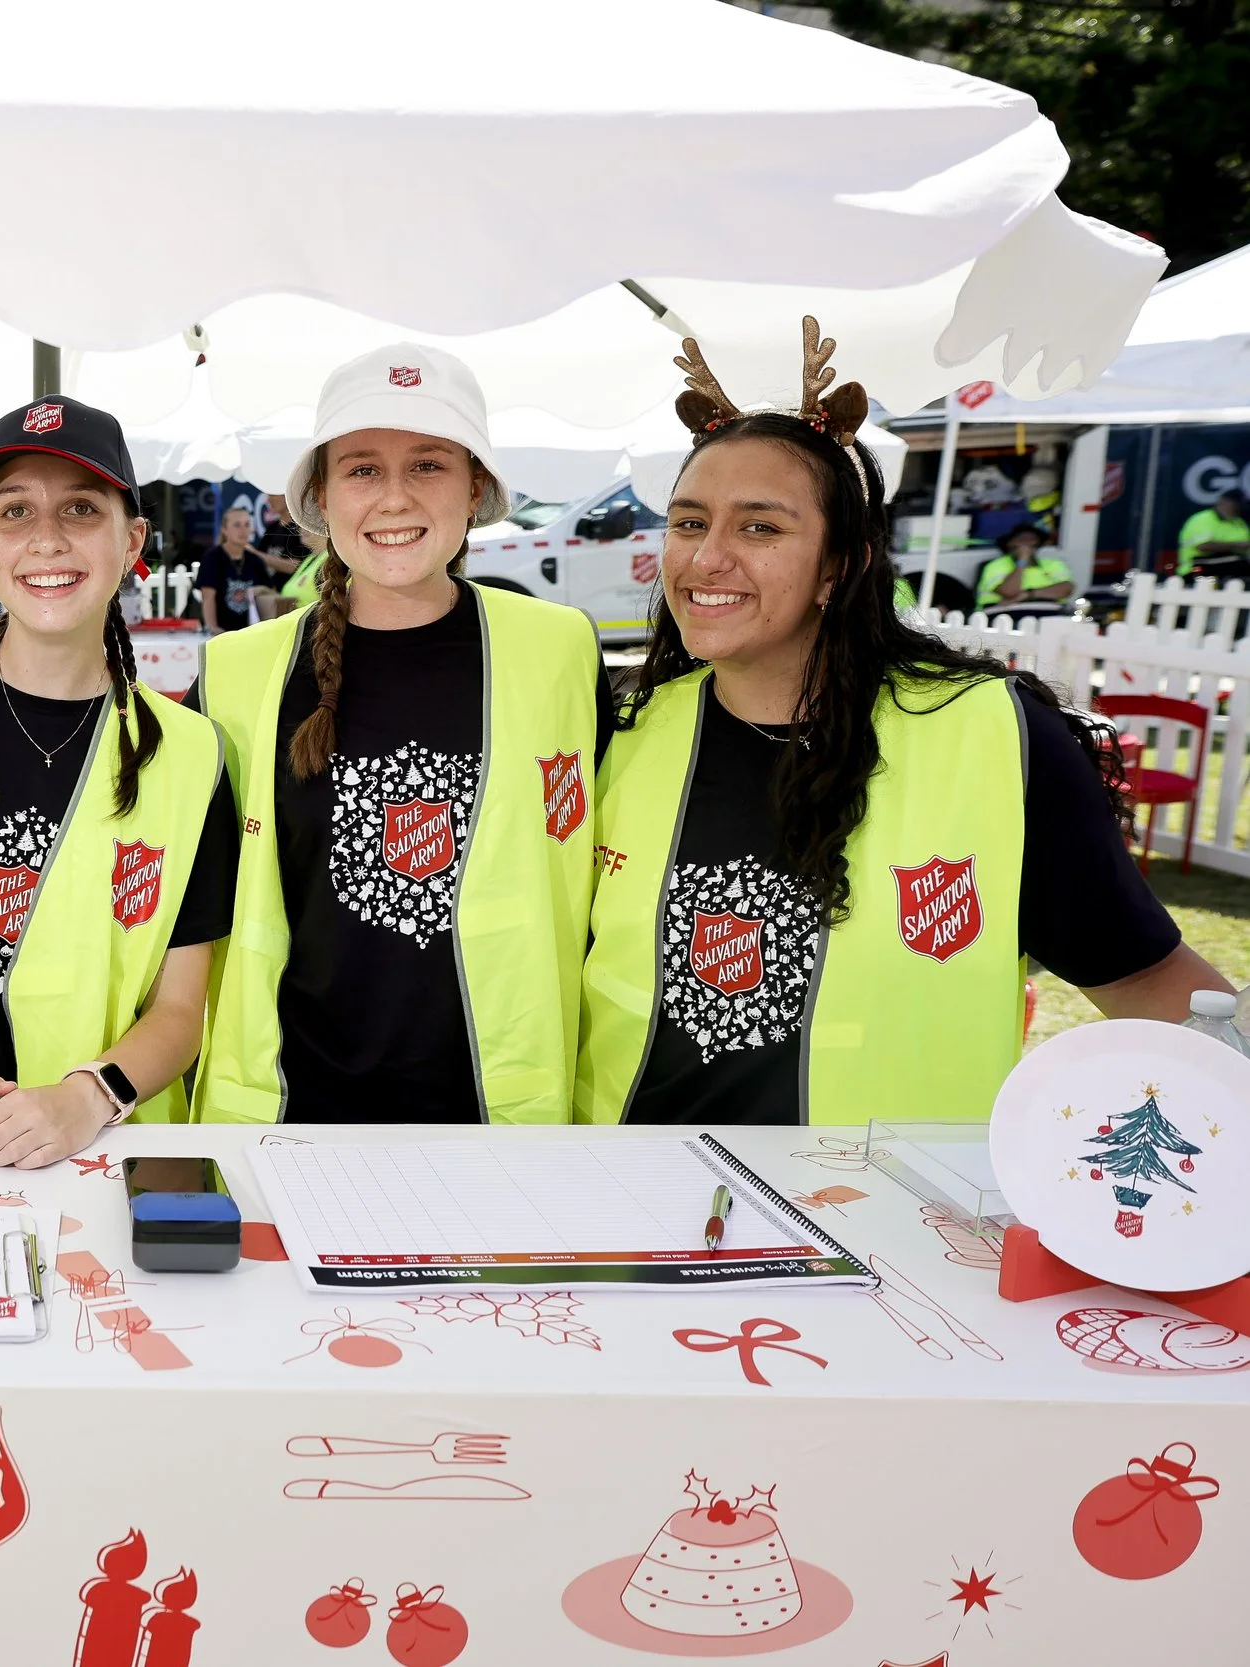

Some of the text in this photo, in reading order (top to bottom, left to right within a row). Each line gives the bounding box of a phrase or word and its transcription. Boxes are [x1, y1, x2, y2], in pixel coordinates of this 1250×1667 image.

[25, 407, 60, 429] SALVATION
[31, 405, 48, 417] THE
[35, 415, 59, 431] ARMY
[544, 759, 579, 821] SALVATION
[548, 757, 564, 790] THE
[395, 804, 423, 833] THE
[556, 787, 578, 835] ARMY
[386, 808, 447, 862] SALVATION
[408, 832, 446, 873] ARMY
[112, 854, 163, 905] SALVATION
[910, 864, 945, 903] THE
[121, 881, 157, 920] ARMY
[904, 866, 972, 941] SALVATION
[704, 918, 733, 944] THE
[931, 897, 971, 953] ARMY
[694, 926, 758, 972] SALVATION
[716, 952, 754, 986] ARMY
[336, 1269, 482, 1280] 3:20pm to 3:40pm
[680, 1268, 721, 1276] TABLE
[720, 1266, 766, 1274] GIVING
